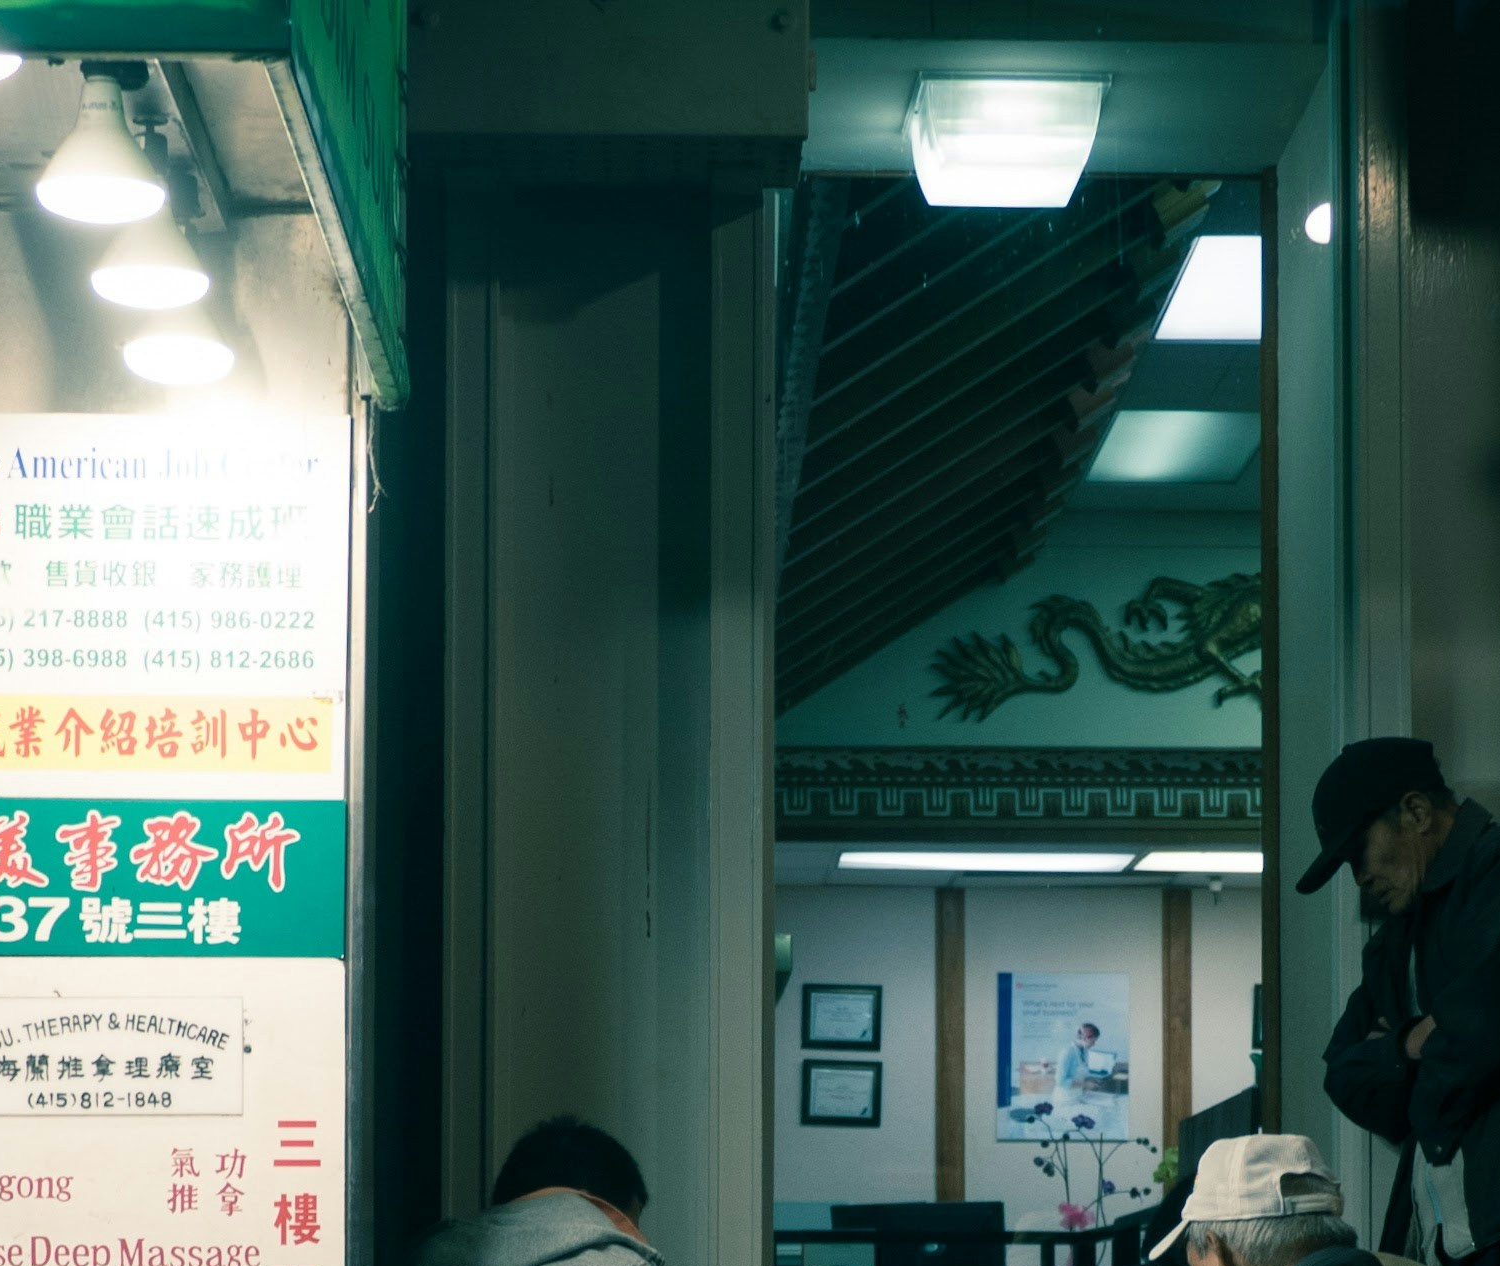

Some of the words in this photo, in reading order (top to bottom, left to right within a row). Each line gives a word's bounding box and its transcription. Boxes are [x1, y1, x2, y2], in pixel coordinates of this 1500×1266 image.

[8, 446, 147, 481] American
[45, 559, 157, 590] 售貨收銀
[23, 609, 129, 630] 217-8888
[143, 609, 202, 632] (415)
[210, 609, 316, 631] 986-0222
[23, 648, 129, 669] 398-6988
[142, 648, 202, 672] (415)
[209, 649, 316, 670] 812-2686
[78, 896, 242, 946] 號三樓
[22, 1012, 104, 1042] THERAPY
[108, 1012, 121, 1031] &
[124, 1012, 230, 1051] HEALTHCARE
[27, 1090, 174, 1110] (415)812-1848
